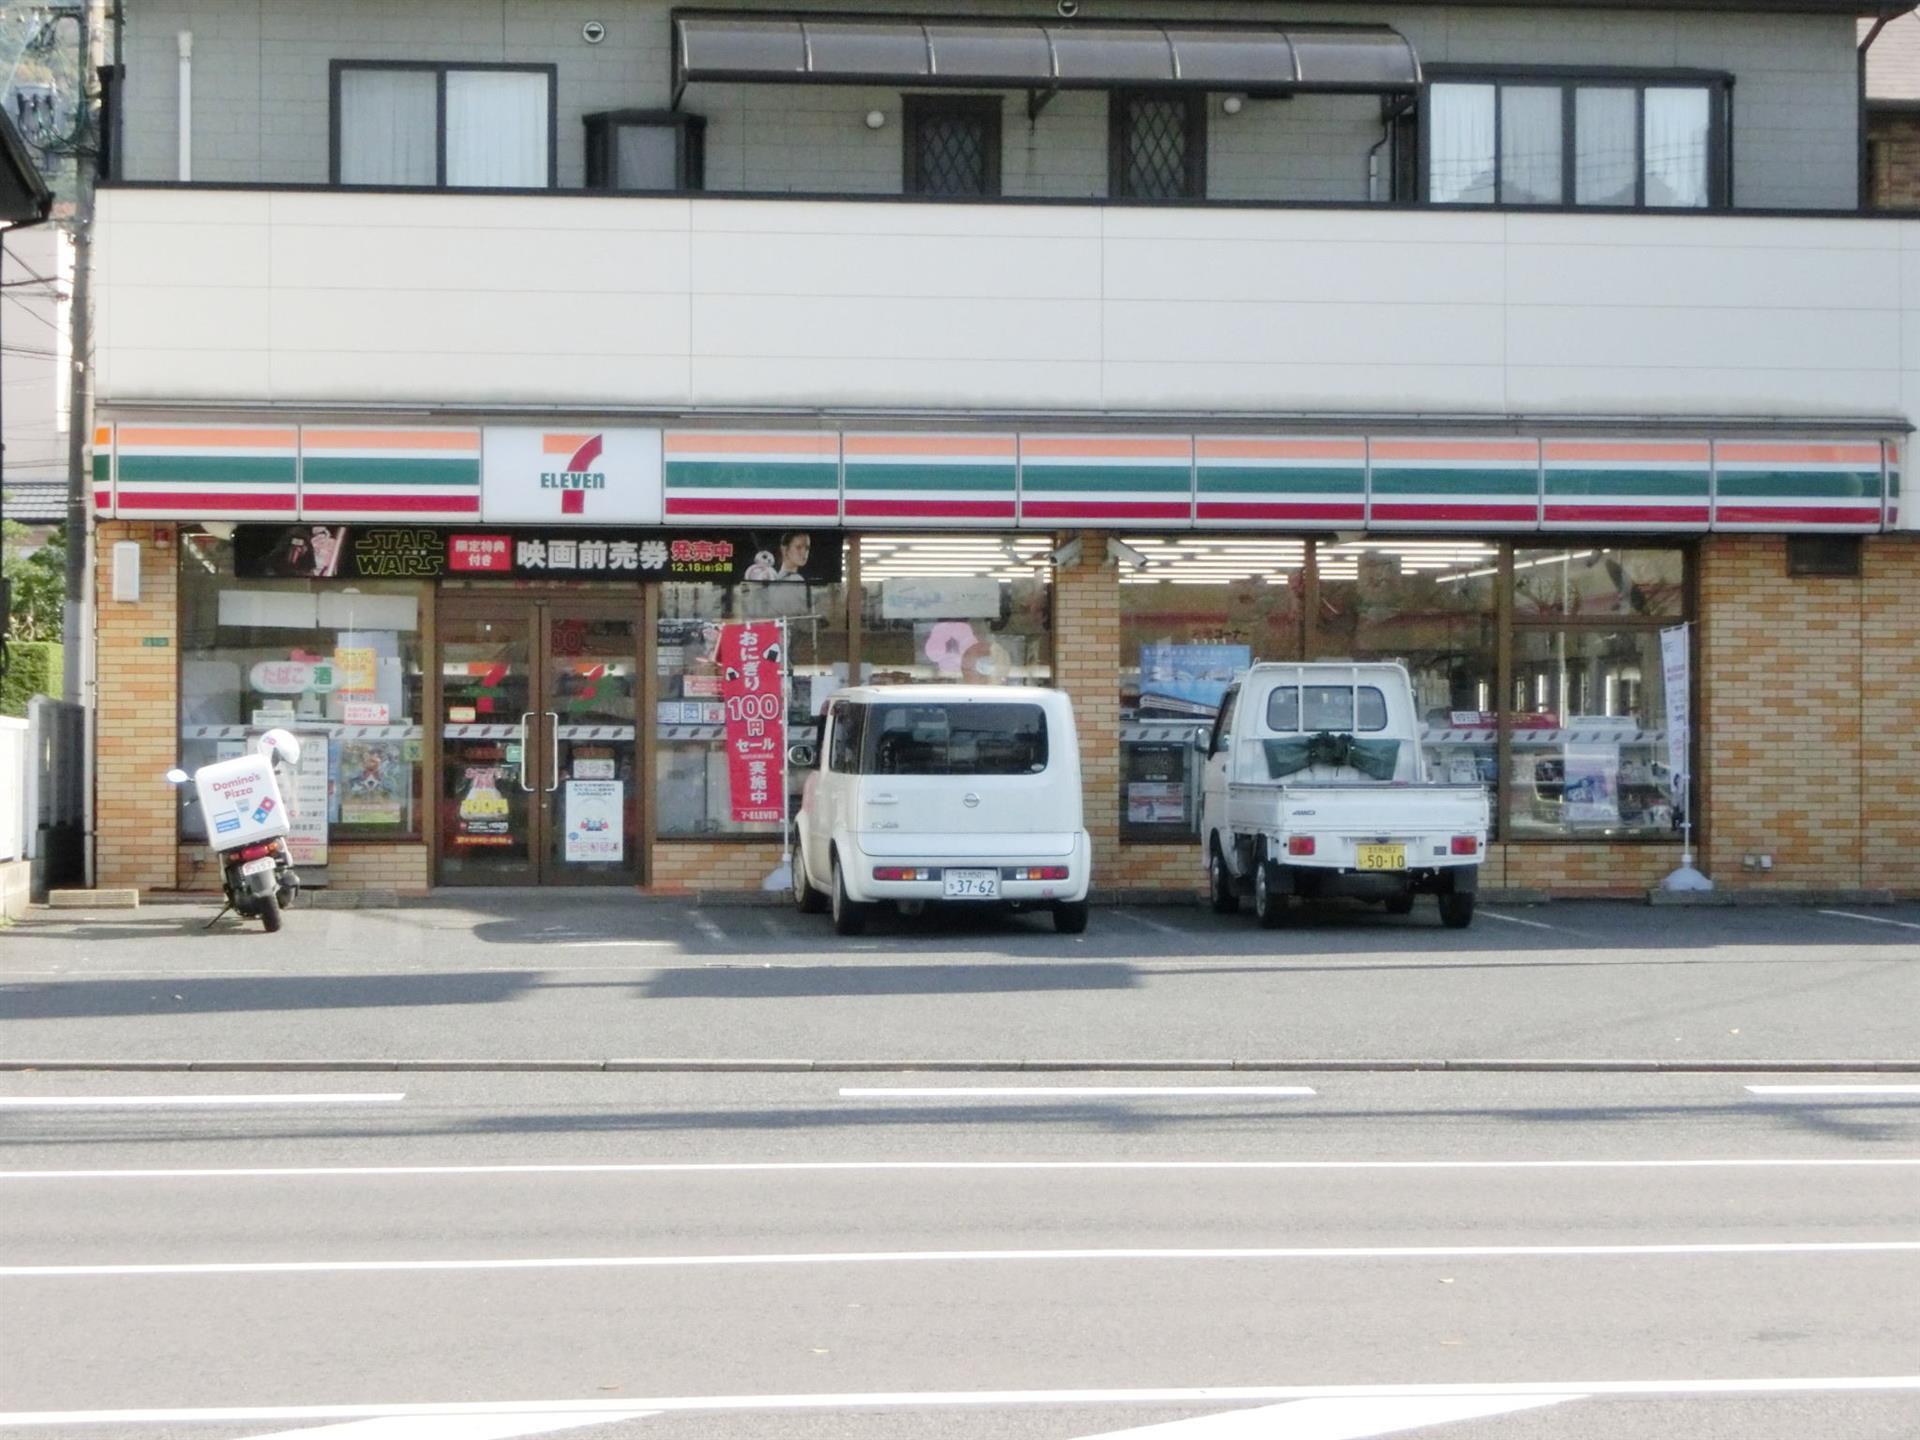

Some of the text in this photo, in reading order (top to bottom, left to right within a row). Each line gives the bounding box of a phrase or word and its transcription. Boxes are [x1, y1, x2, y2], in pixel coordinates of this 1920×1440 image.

[543, 434, 602, 513] 7
[355, 529, 444, 550] STAR
[455, 540, 505, 553] 限定特典
[468, 553, 493, 567] 付き
[516, 539, 668, 570] 映画前売券
[671, 539, 733, 562] 発売中
[356, 555, 444, 576] WARS
[739, 631, 760, 691] おにぎり
[263, 666, 304, 686] たばこ
[313, 666, 333, 685] 酒
[728, 693, 779, 721] 100
[747, 719, 764, 737] 円
[735, 738, 775, 753] セール
[212, 772, 261, 792] Domino's
[749, 761, 768, 804] 実施中
[224, 787, 254, 800] Pizza
[1367, 855, 1405, 868] 50-10
[957, 880, 995, 894] 37-62
